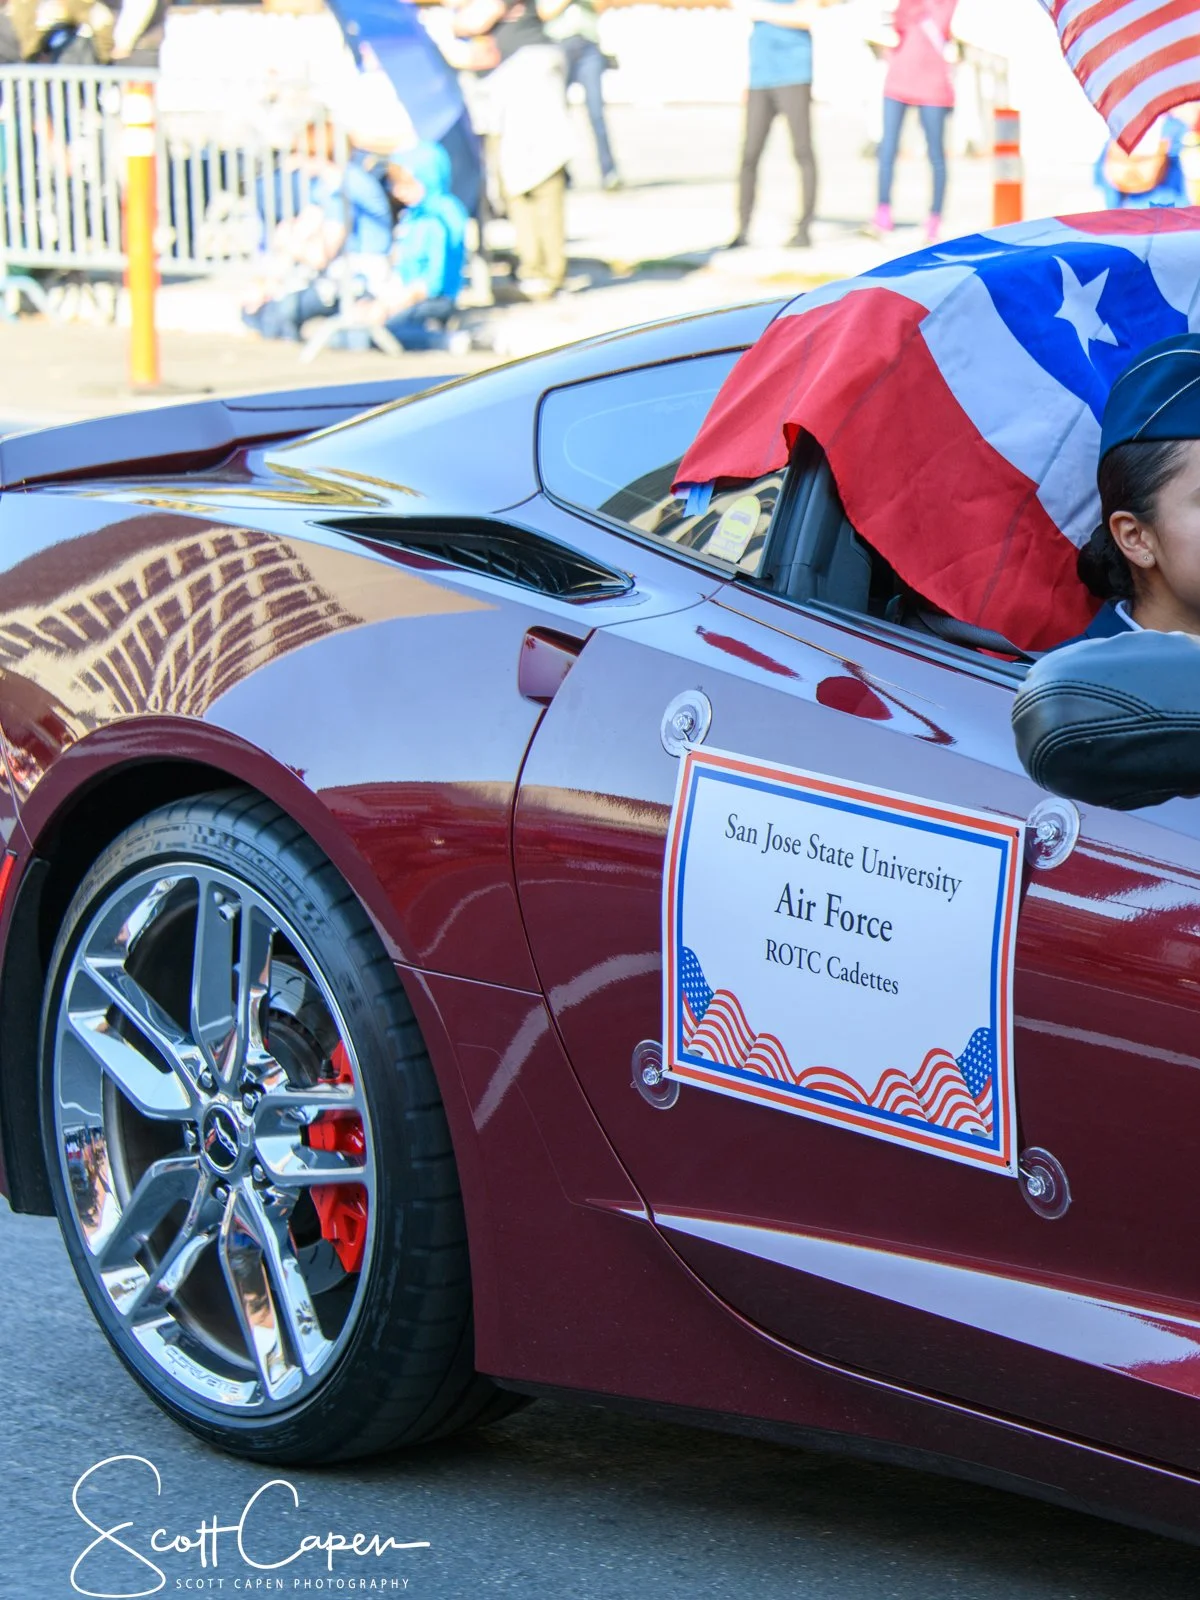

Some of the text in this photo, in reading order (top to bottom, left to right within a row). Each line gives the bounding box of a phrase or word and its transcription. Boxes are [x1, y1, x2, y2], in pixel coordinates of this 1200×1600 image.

[724, 812, 963, 902] San Jose State University
[773, 881, 893, 943] Air Force
[764, 938, 899, 996] ROTC Cadettes
